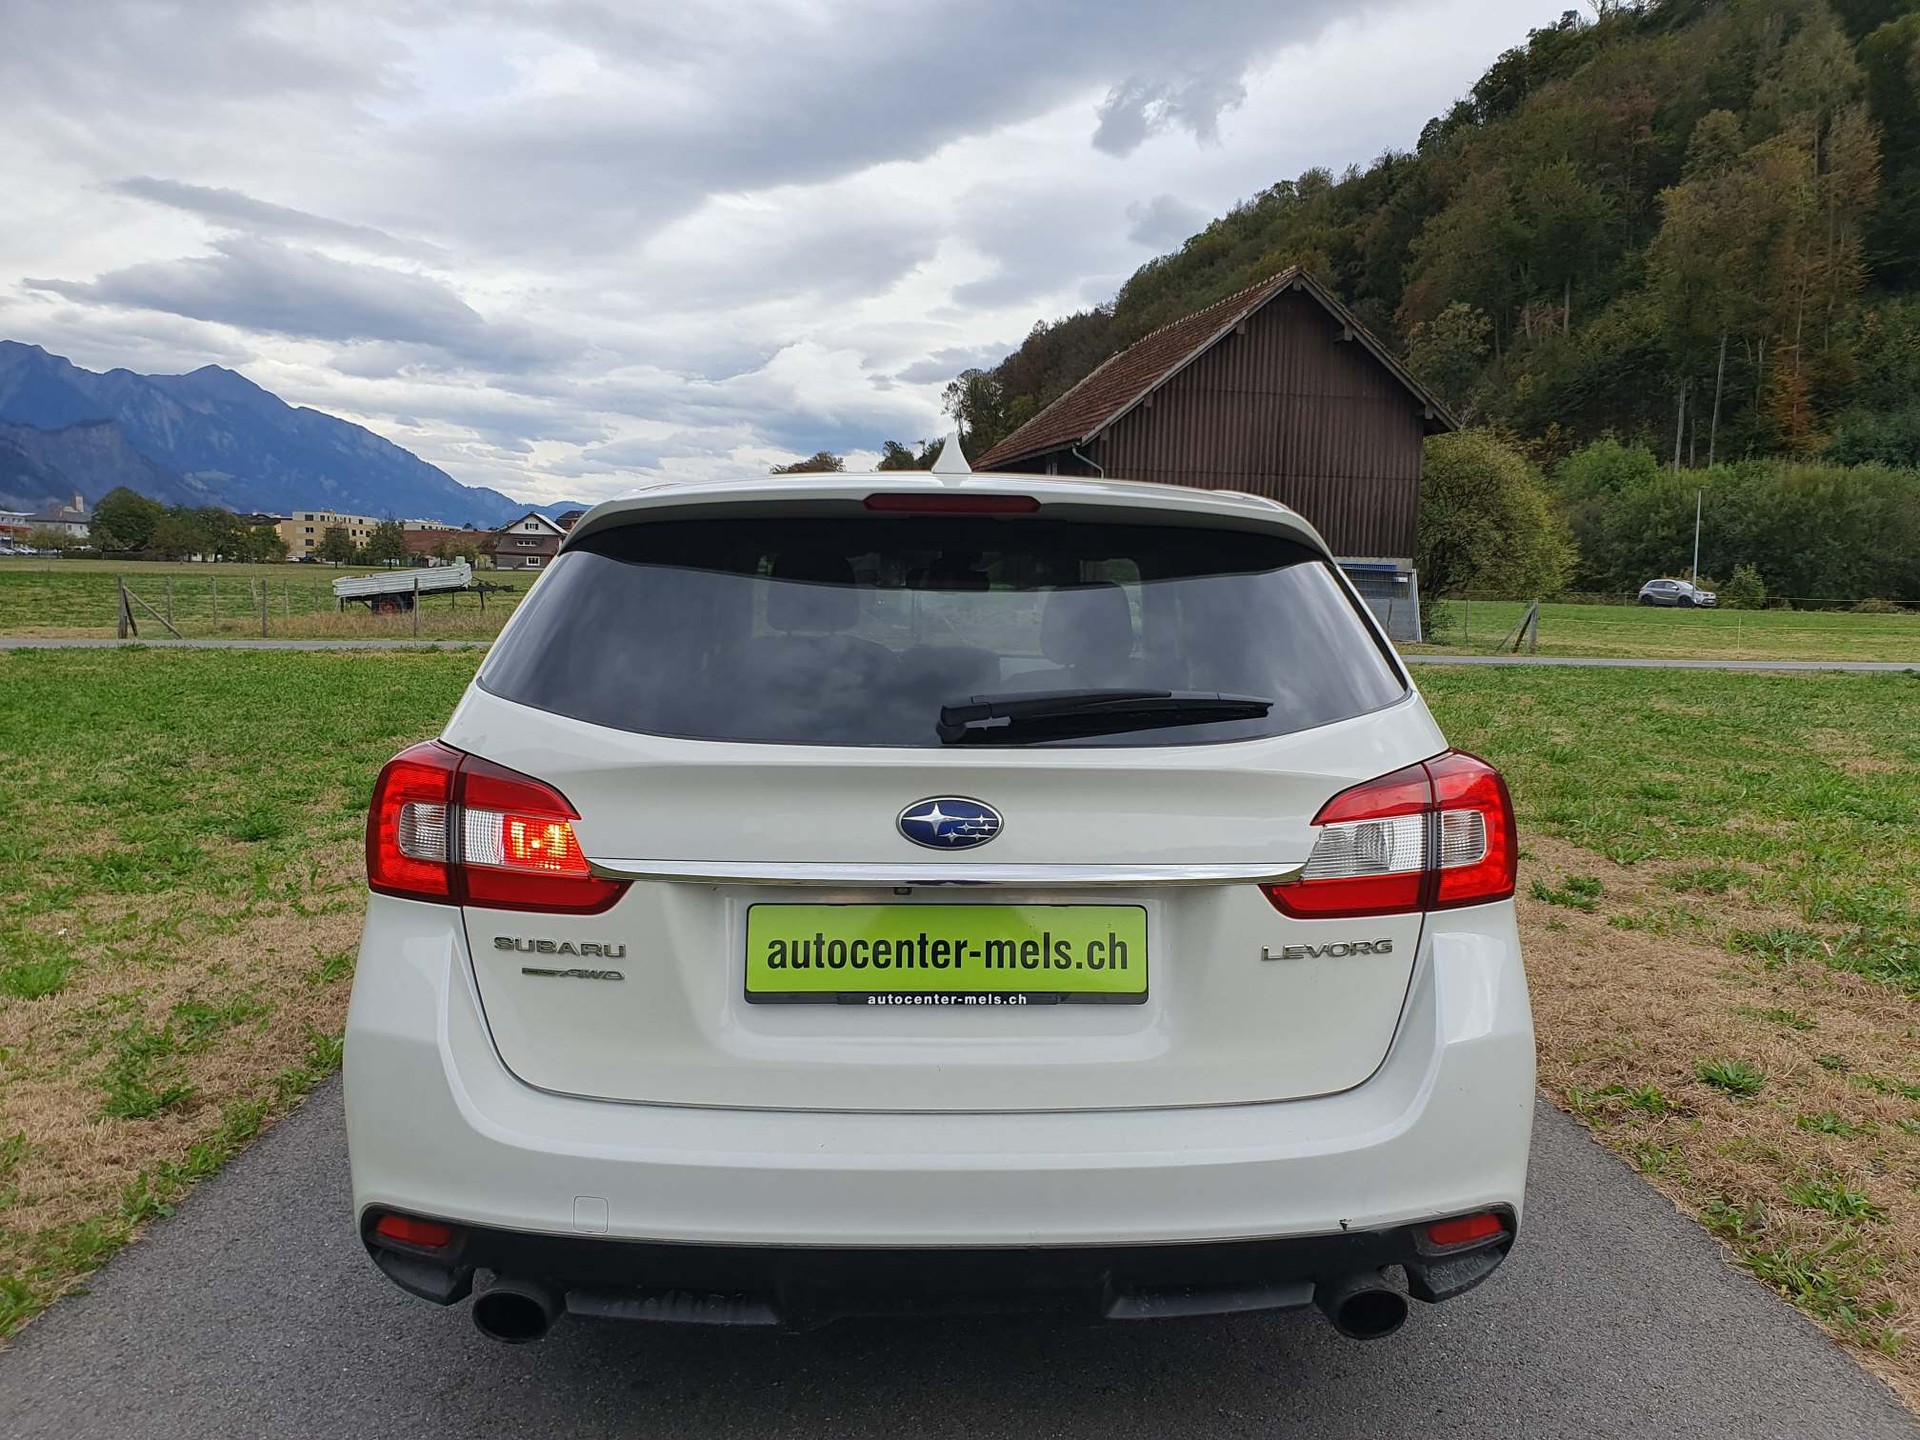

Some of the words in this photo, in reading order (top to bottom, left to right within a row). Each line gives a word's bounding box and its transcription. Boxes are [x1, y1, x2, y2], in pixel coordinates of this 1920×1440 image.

[493, 936, 626, 958] SUBARU
[767, 932, 1128, 969] autocenter-mels.ch
[1261, 938, 1394, 961] LEVORG
[867, 993, 1028, 1006] autocenter-mels.ch
